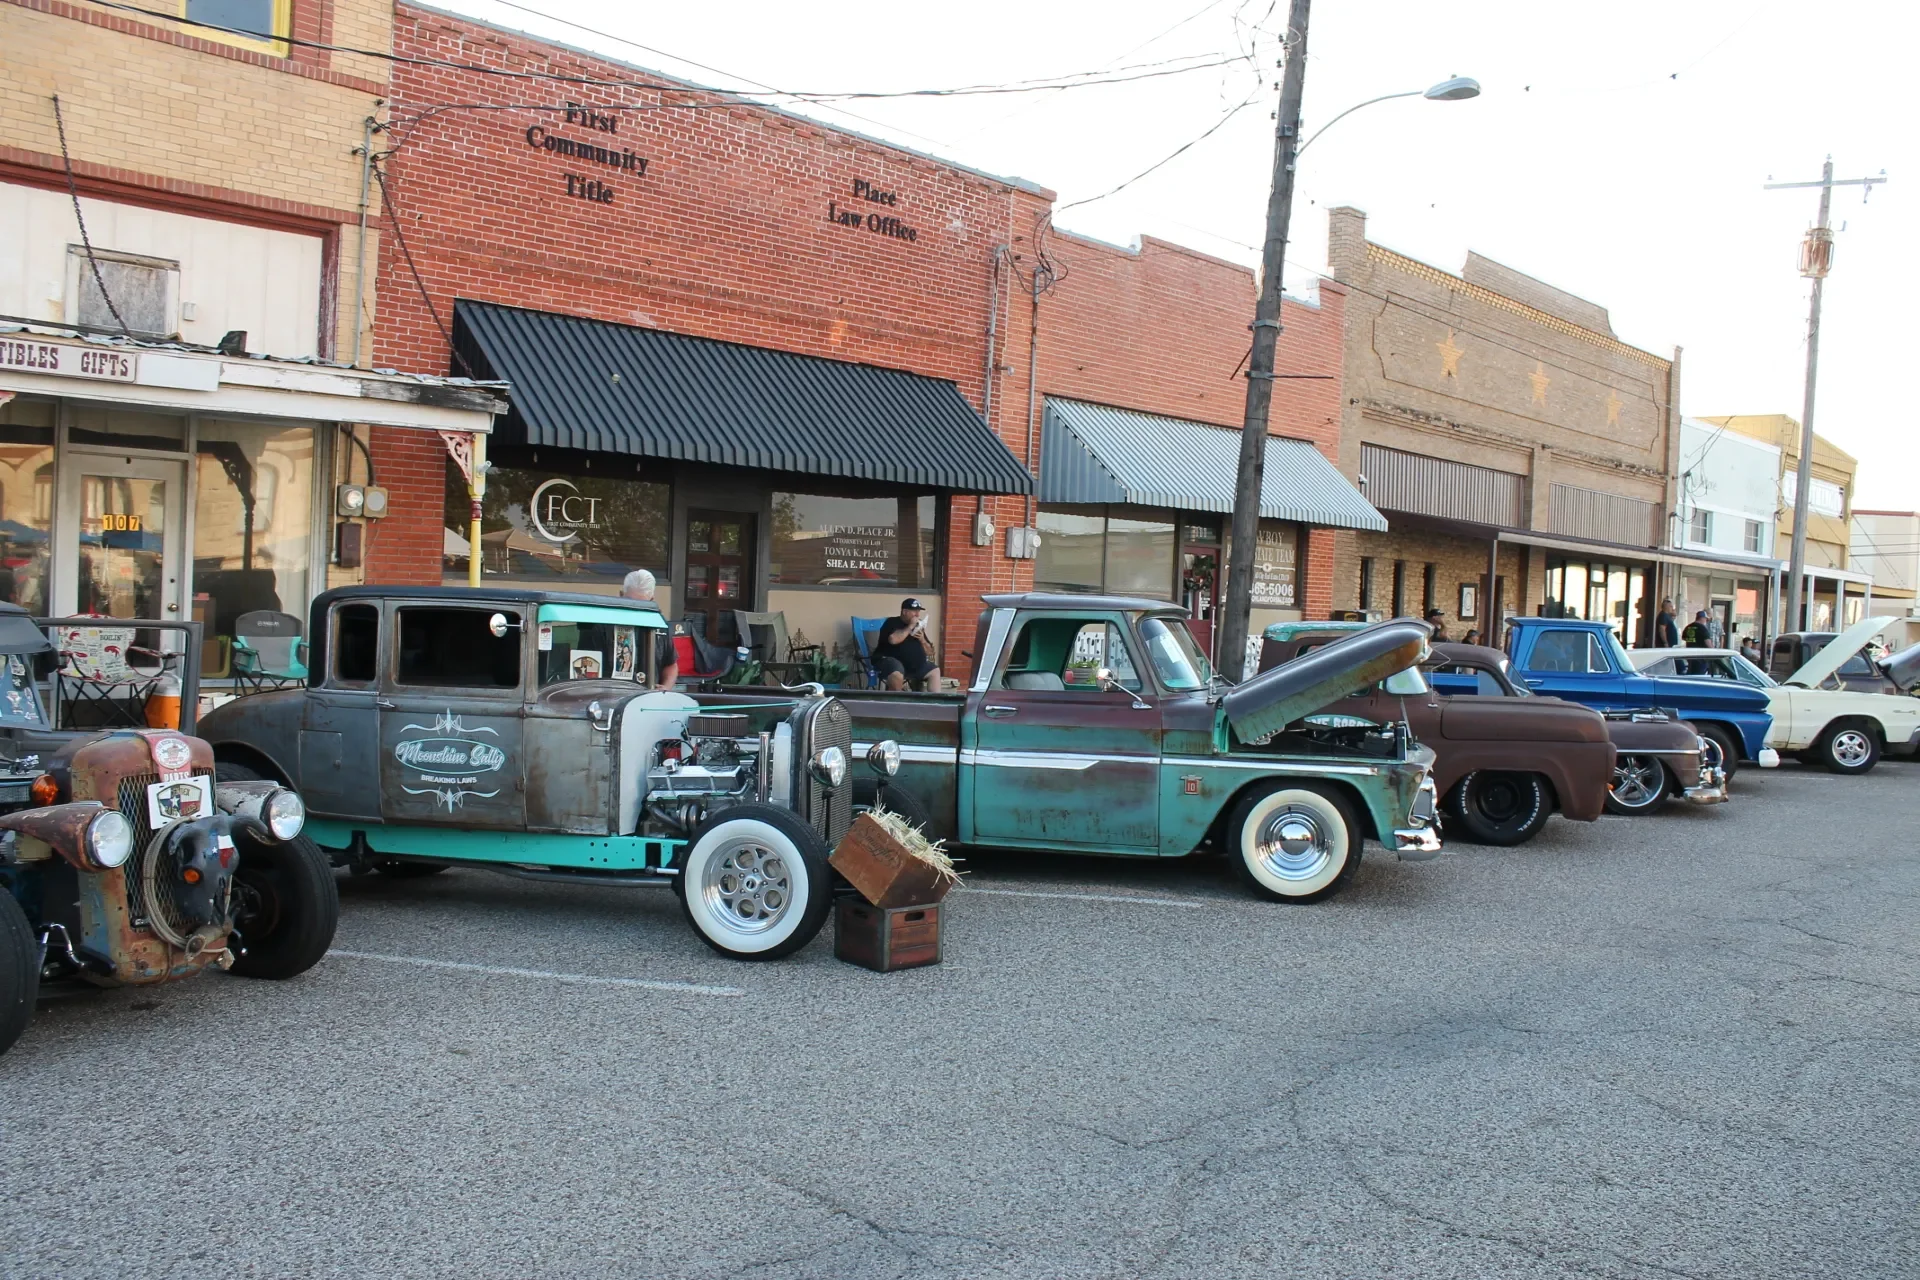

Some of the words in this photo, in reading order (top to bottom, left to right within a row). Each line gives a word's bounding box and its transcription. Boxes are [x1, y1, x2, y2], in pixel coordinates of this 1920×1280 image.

[565, 101, 617, 134] First
[526, 126, 649, 177] Community
[563, 173, 614, 204] Title
[852, 178, 897, 207] Place
[828, 202, 862, 228] Law
[867, 213, 917, 241] Office
[547, 494, 602, 524] FCT
[105, 516, 138, 530] 107
[820, 524, 846, 535] ALLEN
[847, 526, 855, 535] D.
[857, 527, 883, 537] PLACE
[884, 528, 896, 538] JR.
[1256, 530, 1285, 547] WBOY
[824, 546, 851, 557] TONYA
[853, 548, 861, 557] K.
[863, 549, 889, 559] PLACE
[1254, 546, 1274, 562] STATE
[1277, 549, 1295, 563] TEAM
[826, 558, 848, 569] SHEA
[850, 560, 858, 569] E.
[859, 560, 886, 571] PLACE
[395, 741, 468, 765] Moonshine
[469, 744, 505, 772] Sally
[421, 774, 456, 785] BREAKING
[457, 775, 478, 785] LAWS
[1187, 782, 1197, 792] 10
